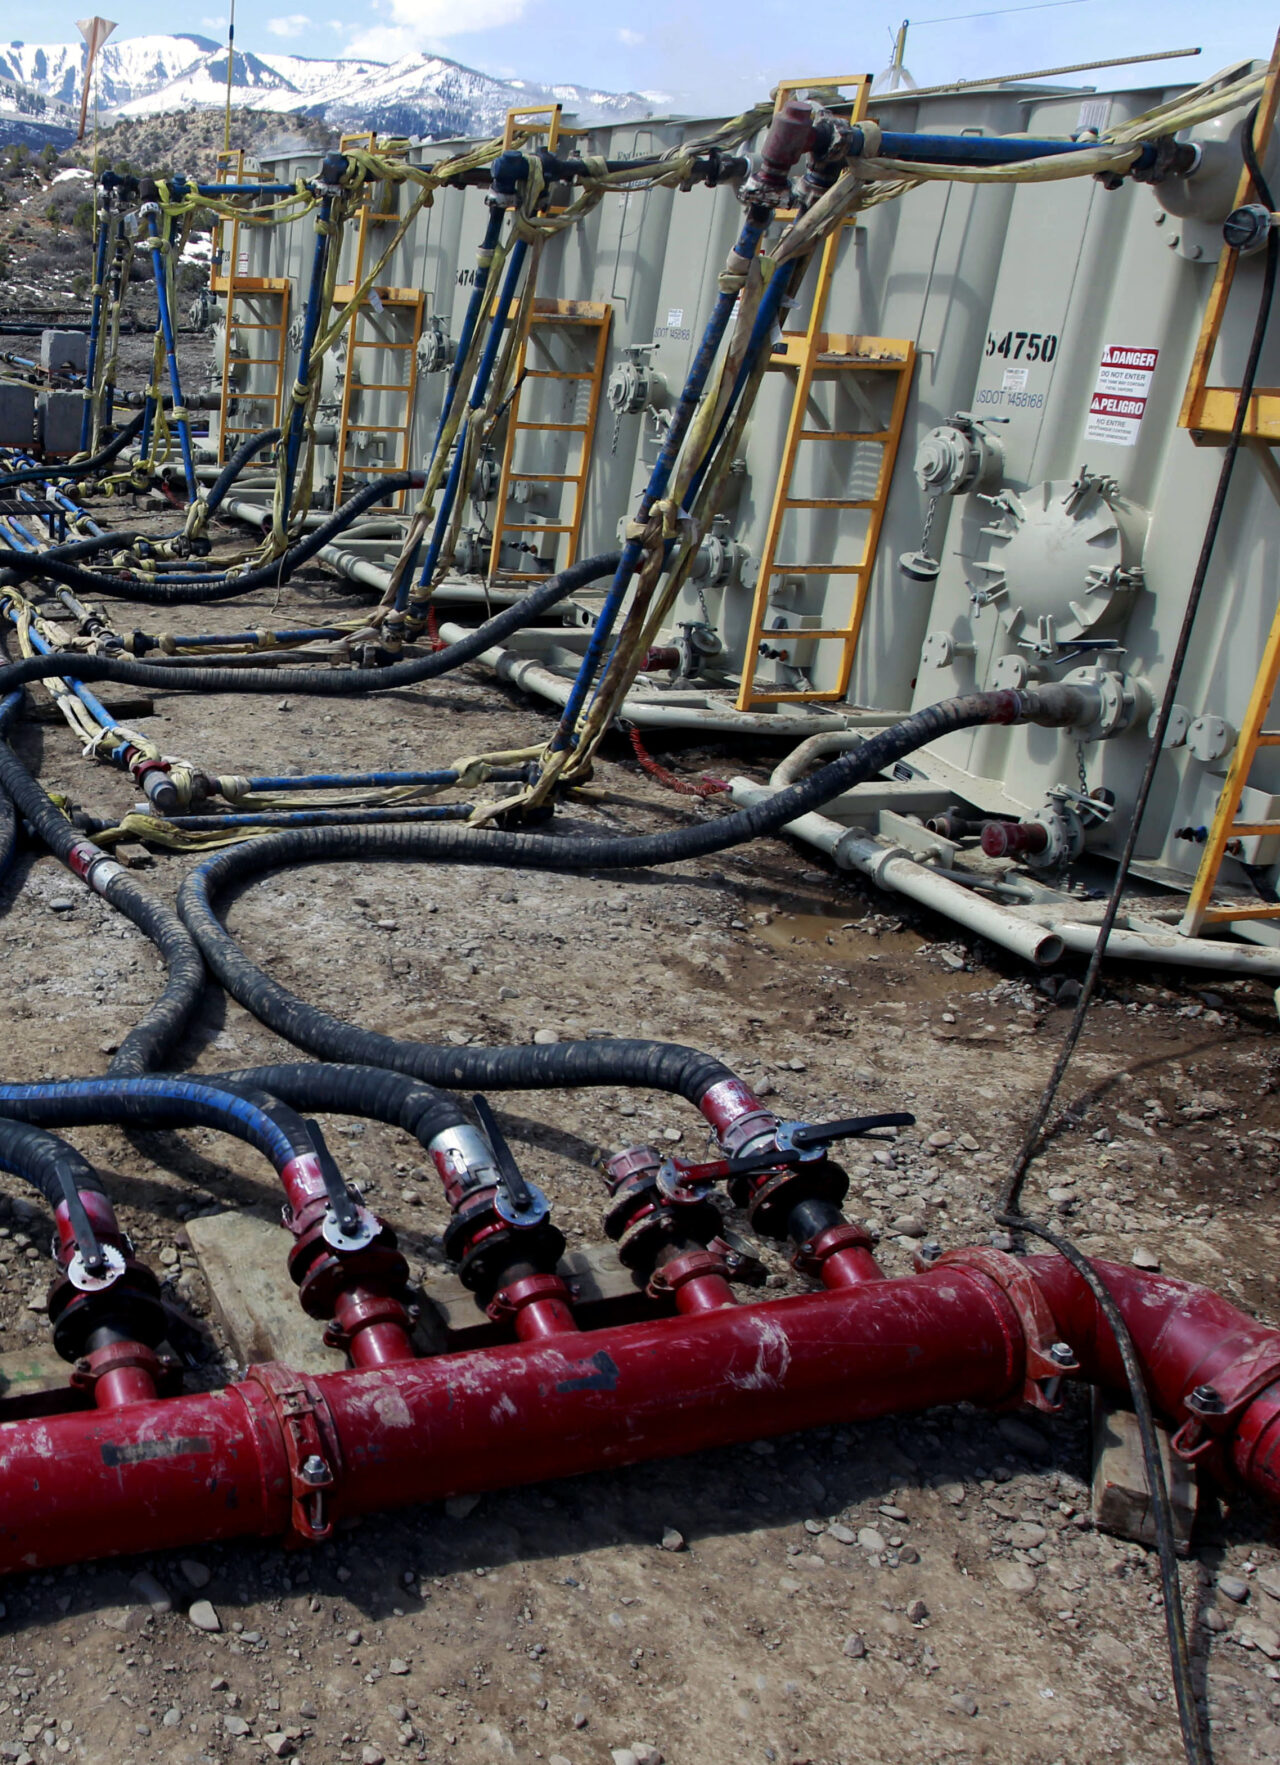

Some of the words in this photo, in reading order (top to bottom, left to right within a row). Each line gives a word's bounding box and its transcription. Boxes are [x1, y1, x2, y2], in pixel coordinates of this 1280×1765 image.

[1111, 350, 1156, 367] DANGER
[1101, 370, 1109, 378] DO
[1110, 371, 1124, 379] NOT
[1124, 372, 1146, 381] ENTER
[1008, 392, 1044, 409] 1458168
[1101, 398, 1144, 415] PELIGRO
[1105, 419, 1126, 428] ENTRE
